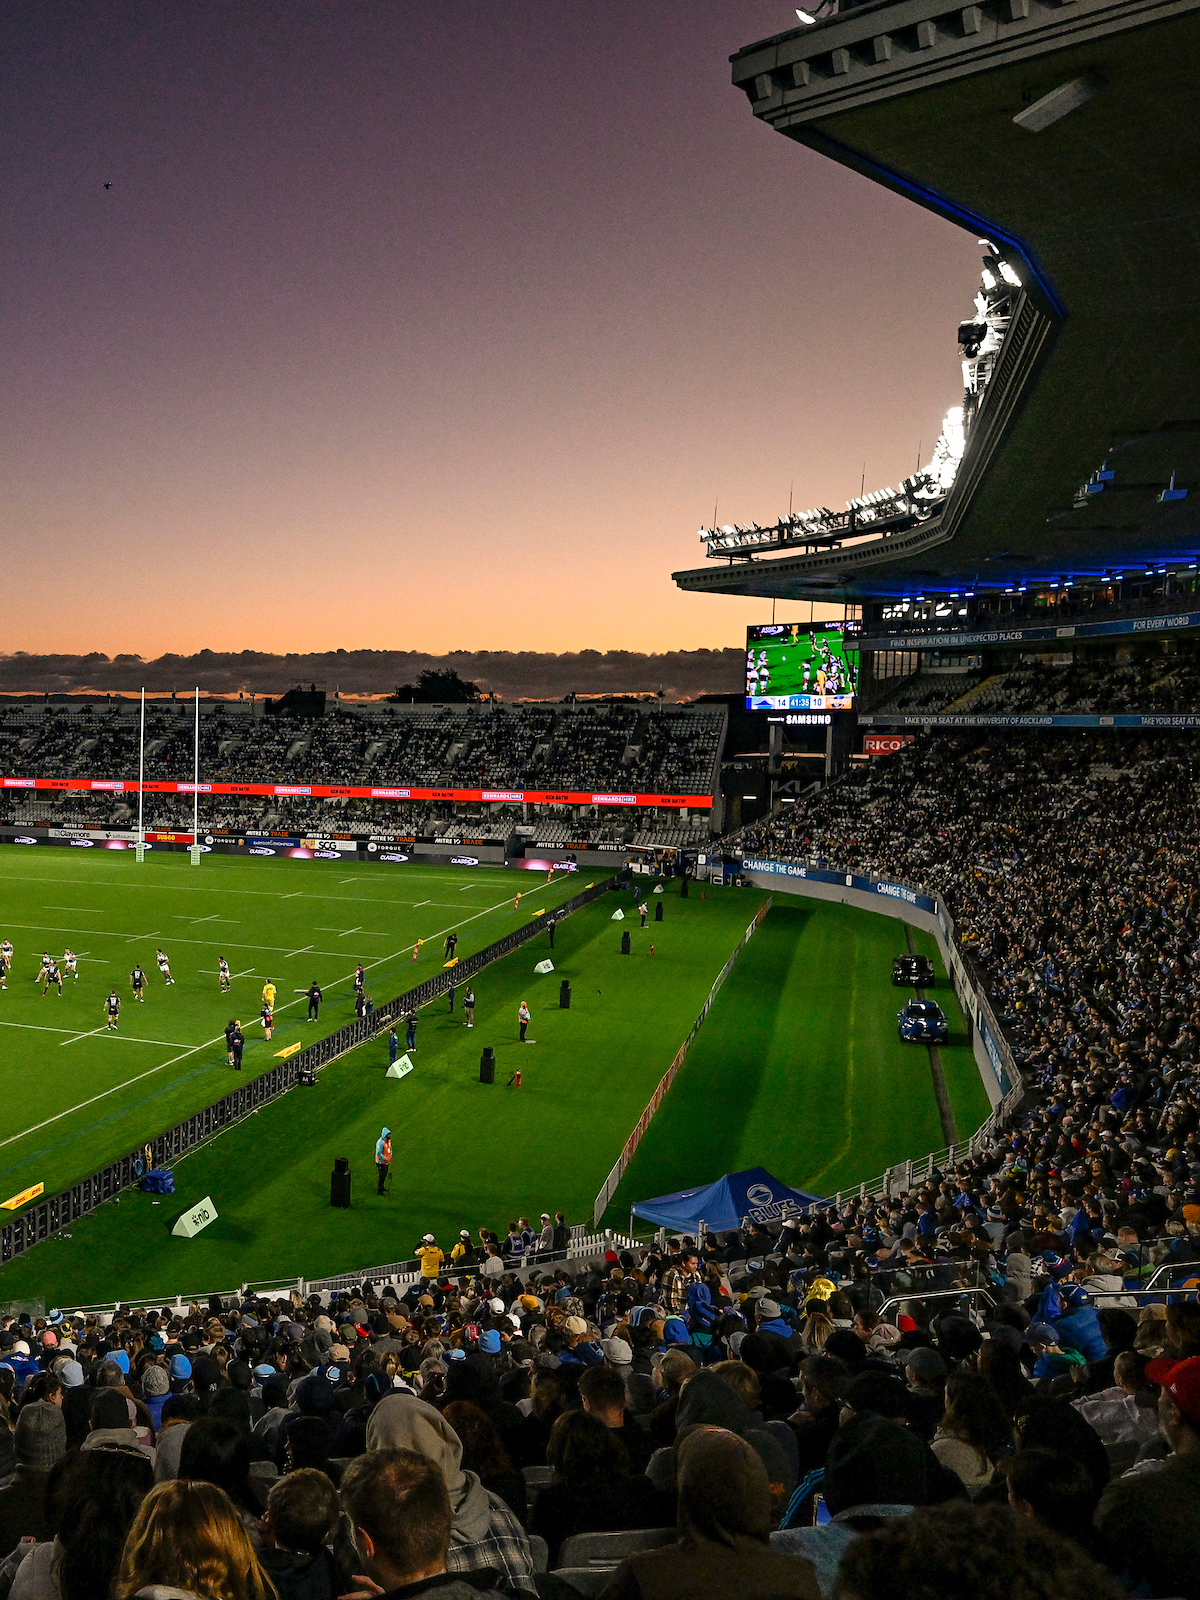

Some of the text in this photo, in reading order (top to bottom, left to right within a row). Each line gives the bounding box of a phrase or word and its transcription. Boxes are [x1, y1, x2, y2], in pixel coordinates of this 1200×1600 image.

[1134, 616, 1189, 630] FOR EVERY WORLD
[906, 638, 948, 646] INSPIRATION
[960, 634, 998, 643] UNEXPECTED
[999, 632, 1023, 640] PLACES
[786, 714, 831, 724] SAMSUNG
[1141, 717, 1155, 725] TAKE
[1156, 717, 1171, 725] YOUR
[1172, 717, 1186, 725] SEAT
[1186, 717, 1194, 725] AT
[60, 830, 90, 838] Claymore
[318, 842, 336, 850] SCG
[742, 860, 806, 877] CHANGE THE GAME
[878, 882, 900, 897] CHANGE
[198, 1208, 210, 1224] nib
[748, 1198, 803, 1224] BLUES
